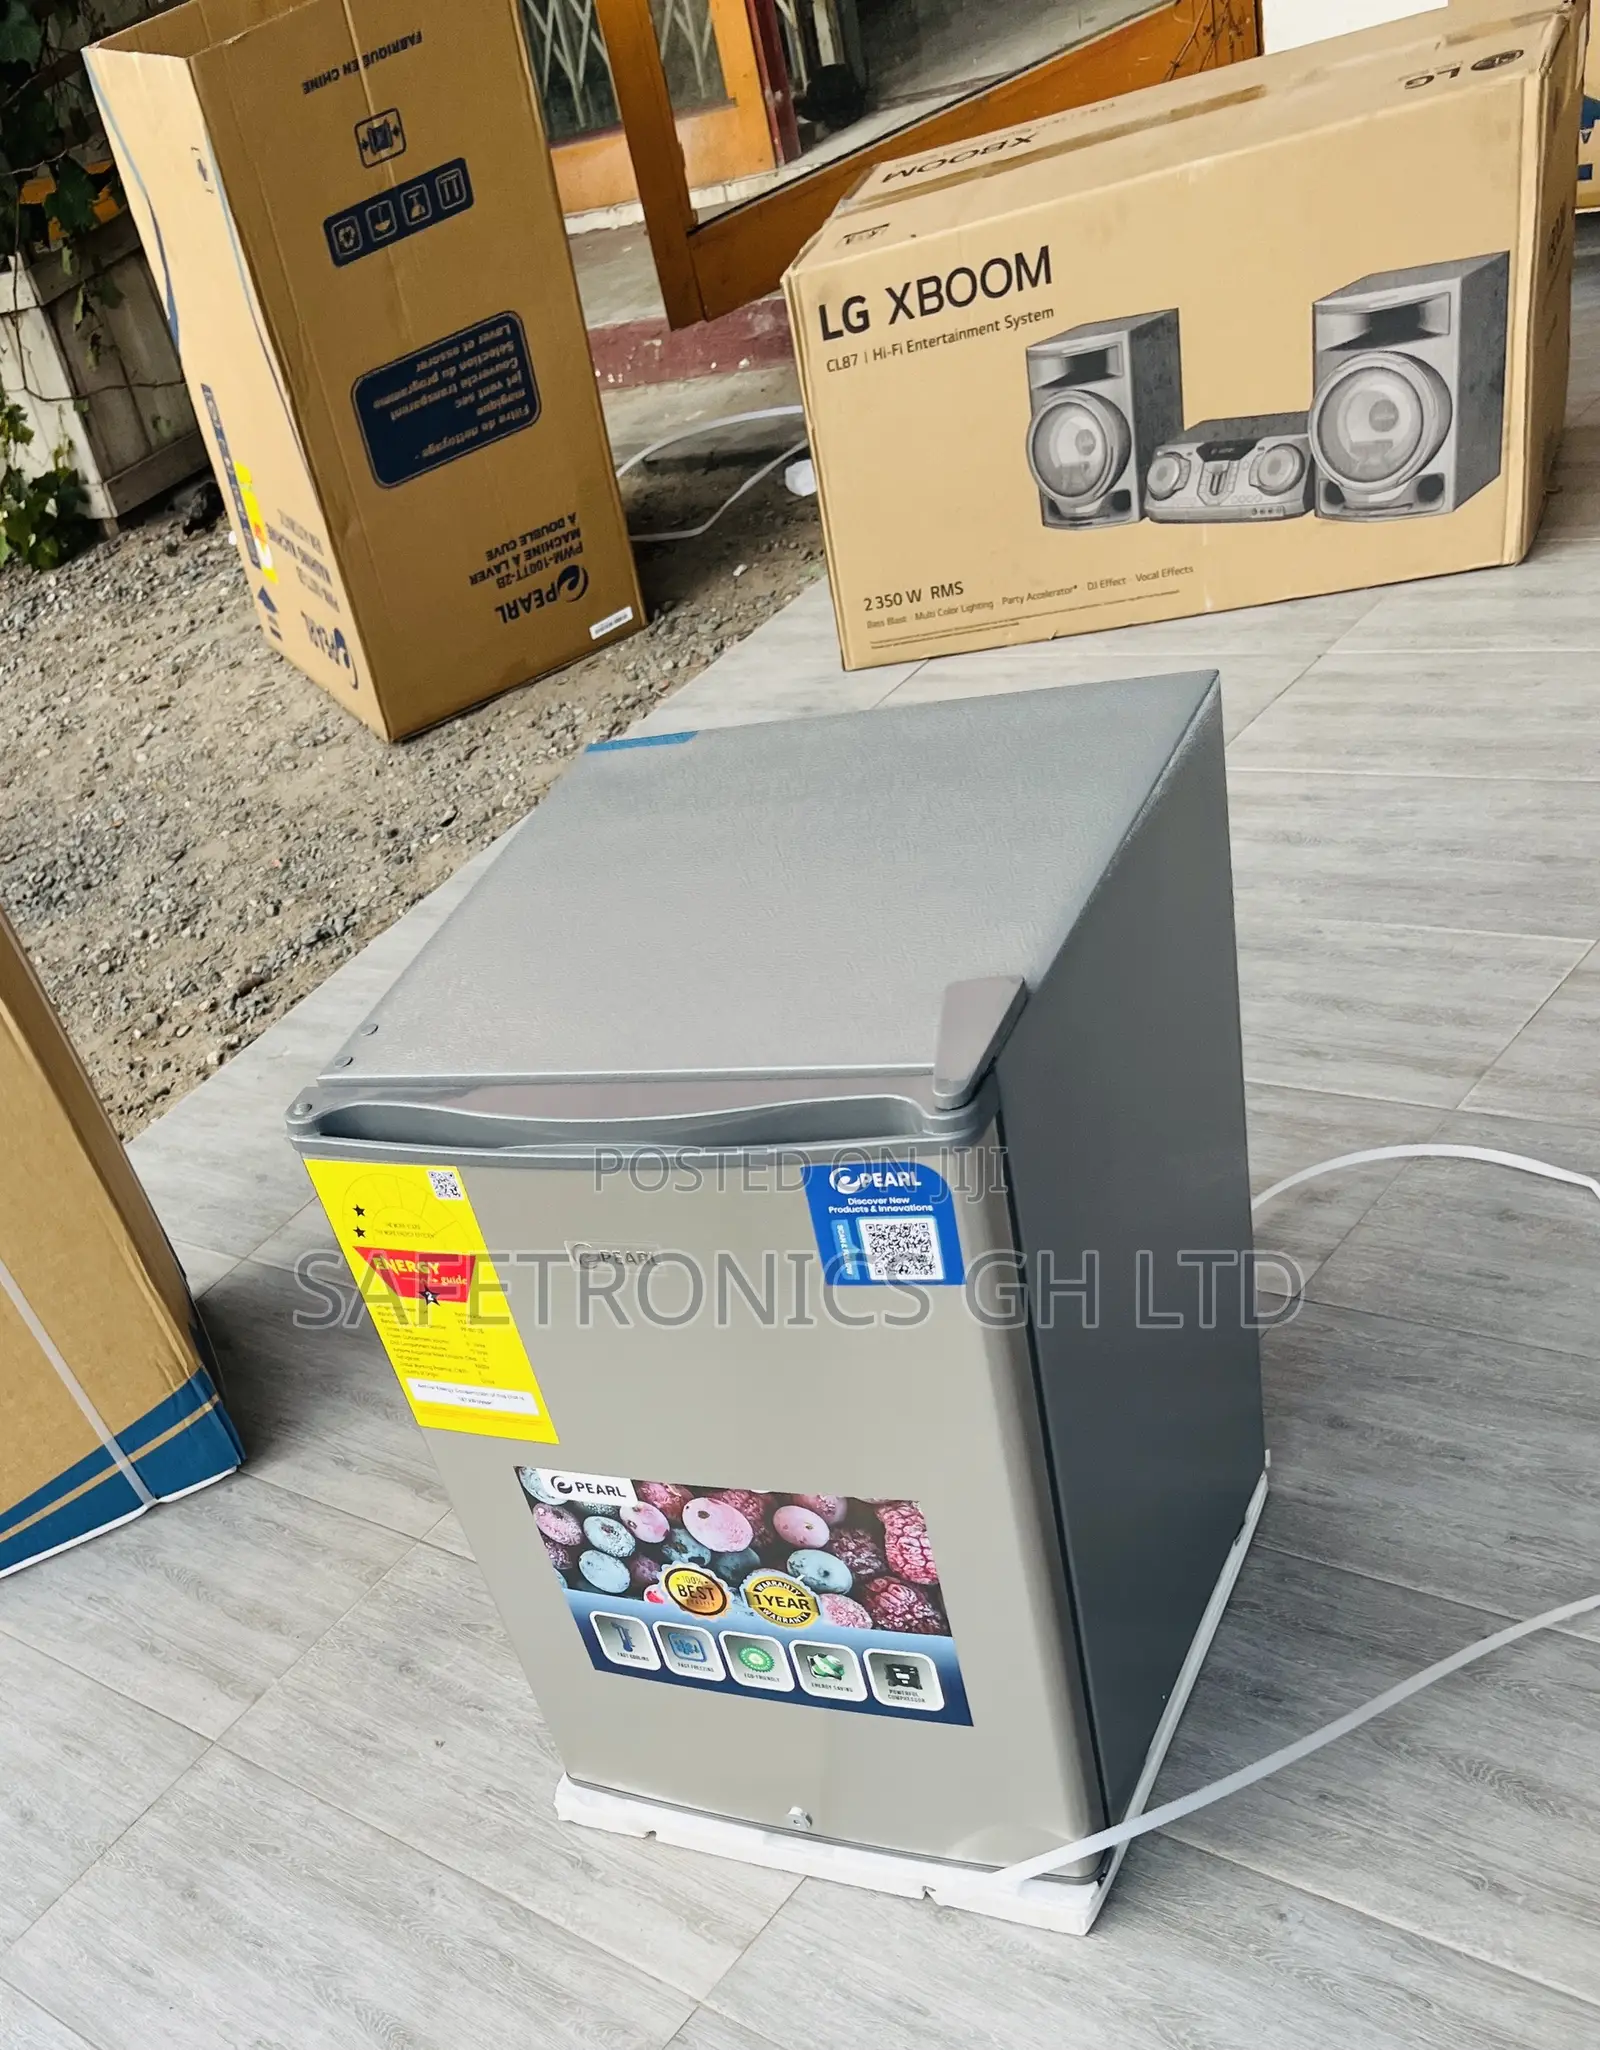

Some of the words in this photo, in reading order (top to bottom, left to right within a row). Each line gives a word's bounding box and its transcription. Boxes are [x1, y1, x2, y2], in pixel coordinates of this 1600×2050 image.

[302, 67, 340, 95] CHINE
[881, 132, 1039, 184] XBOOM
[818, 294, 871, 342] LG
[884, 244, 1053, 325] XBOOM
[826, 353, 858, 373] CL87
[872, 342, 904, 362] Hi-Fi
[906, 321, 1001, 354] Entertainment
[1003, 306, 1055, 333] System
[518, 516, 566, 547] DOUBLE
[485, 539, 518, 562] CUVE
[523, 527, 582, 561] MACHINE
[468, 559, 510, 586] LAVER
[905, 588, 922, 604] W
[930, 580, 964, 600] RMS
[937, 606, 959, 617] Color
[961, 599, 995, 615] Lighting
[1001, 595, 1025, 605] Party
[1099, 576, 1127, 589] Effect
[1135, 569, 1160, 583] Vocal
[1161, 565, 1194, 578] Effects
[494, 582, 560, 624] PEARL
[859, 1171, 922, 1188] PEARL
[828, 1206, 869, 1214] Products
[879, 1203, 934, 1213] Innovations
[847, 1197, 888, 1205] Discover
[836, 1223, 847, 1244] SCAN
[372, 1256, 440, 1276] ENERGY
[599, 1249, 660, 1267] PEARL
[440, 1274, 467, 1286] guide
[425, 1291, 434, 1301] 2
[574, 1480, 627, 1499] PEARL
[677, 1583, 715, 1601] BEST
[755, 1580, 802, 1598] WARRANTY
[762, 1609, 809, 1624] WARRANTY
